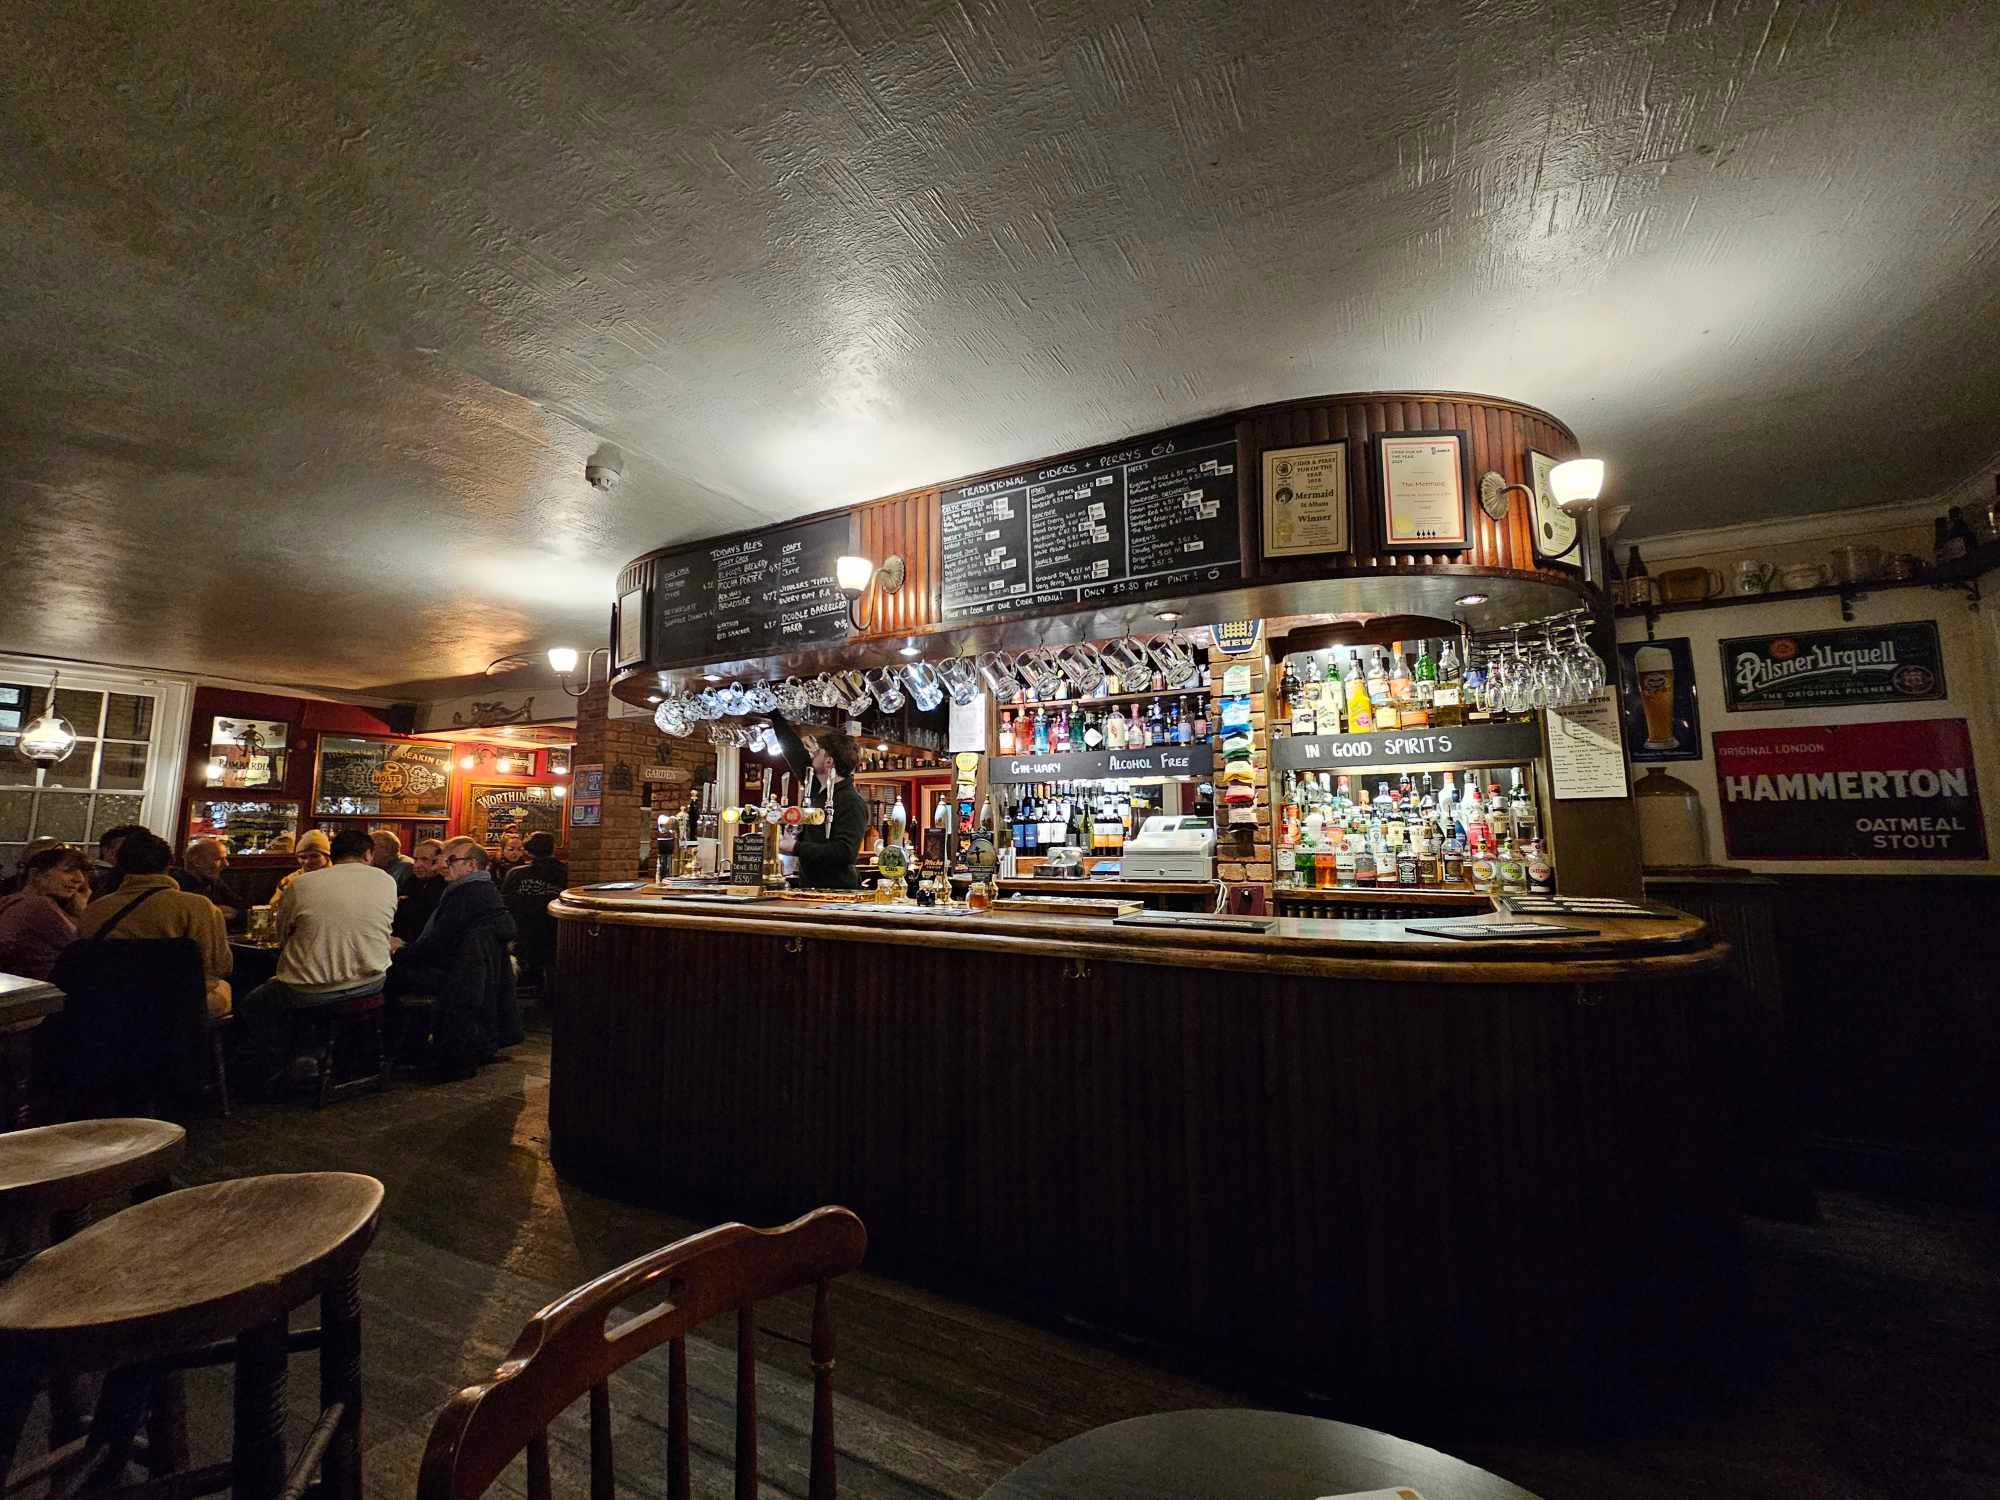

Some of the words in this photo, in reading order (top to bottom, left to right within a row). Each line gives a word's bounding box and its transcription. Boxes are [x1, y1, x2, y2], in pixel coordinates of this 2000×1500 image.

[958, 474, 1028, 498] TRADITIONAL
[1038, 462, 1078, 480] CIDERS
[1099, 449, 1141, 467] PERRYS
[1295, 488, 1334, 500] Mermaid
[1298, 513, 1332, 523] Winner
[1084, 586, 1106, 599] ONLY
[1113, 580, 1140, 594] £5.30
[1167, 573, 1189, 585] PINT
[969, 605, 983, 616] LOOK
[986, 603, 995, 612] AT
[998, 601, 1011, 610] OUR
[1736, 652, 1815, 695] Pilsner
[1812, 641, 1897, 675] Urquell
[1304, 743, 1320, 759] IN
[1332, 741, 1373, 759] GOOD
[1384, 735, 1453, 755] SPIRITS
[1719, 746, 1772, 757] ORIGINAL
[1775, 743, 1825, 754] LONDON
[1109, 755, 1153, 771] ALCOHOL
[1160, 752, 1190, 768] FREE
[1725, 767, 1970, 803] HAMMERTON
[1855, 816, 1966, 834] OATMEAL
[1873, 834, 1951, 850] STOUT
